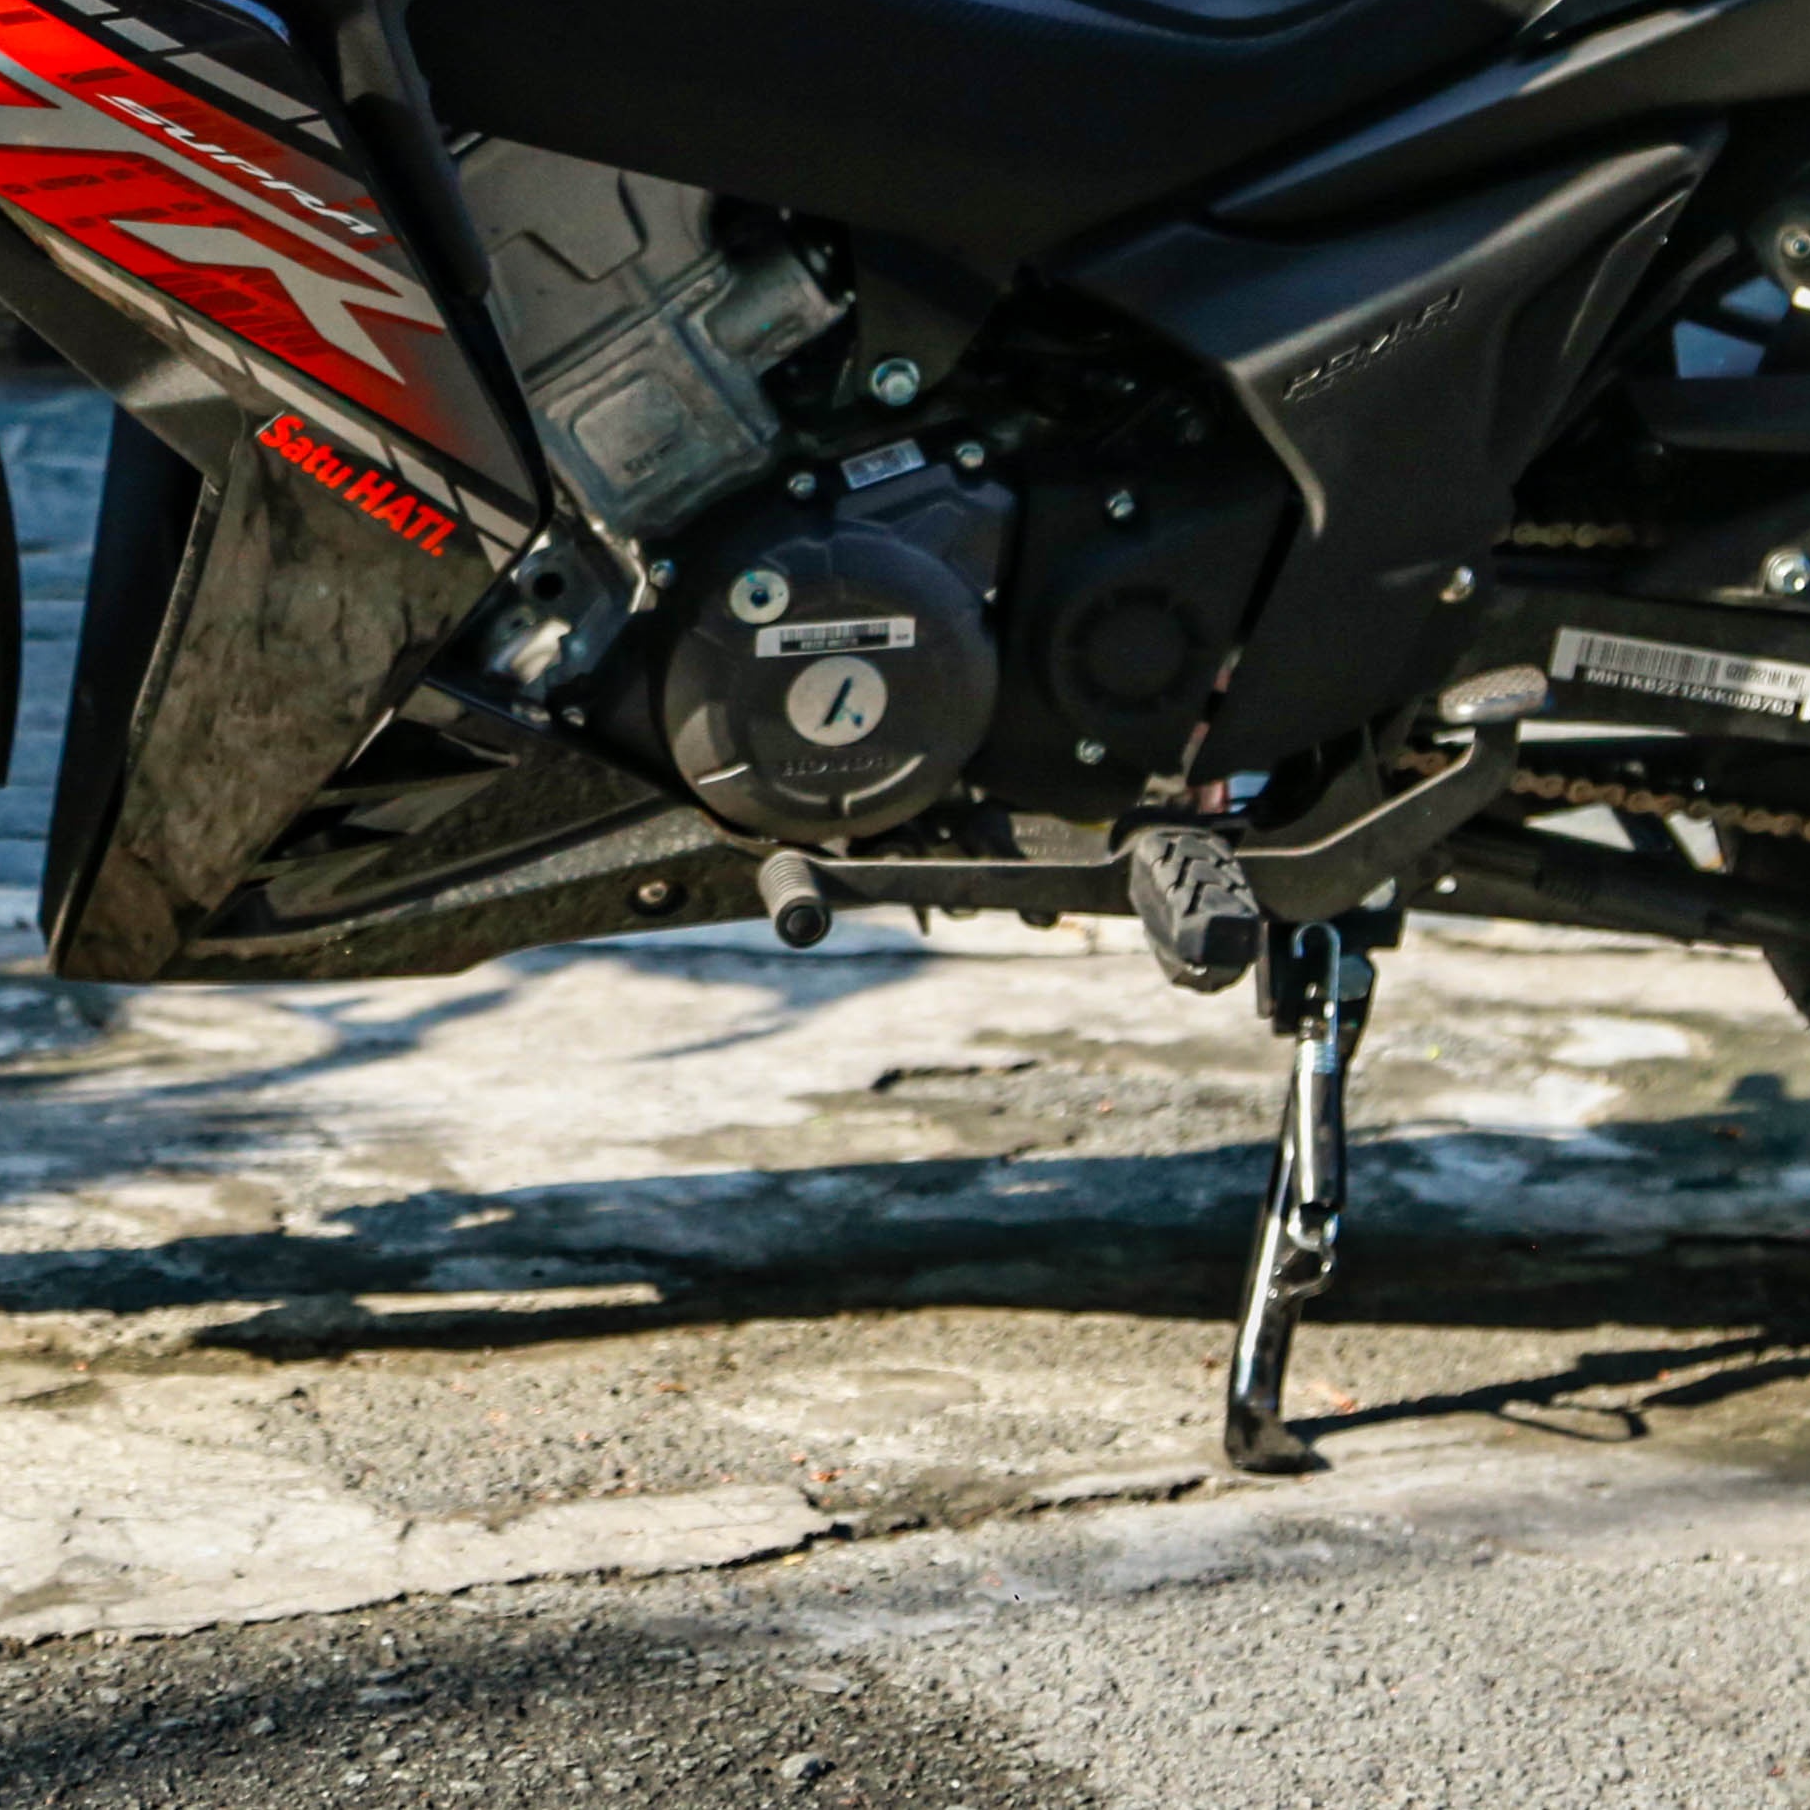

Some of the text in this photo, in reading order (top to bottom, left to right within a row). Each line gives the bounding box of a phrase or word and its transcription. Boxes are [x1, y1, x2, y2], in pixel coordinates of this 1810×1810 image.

[98, 92, 377, 238] SUPRA
[260, 412, 456, 557] Satu HATI.
